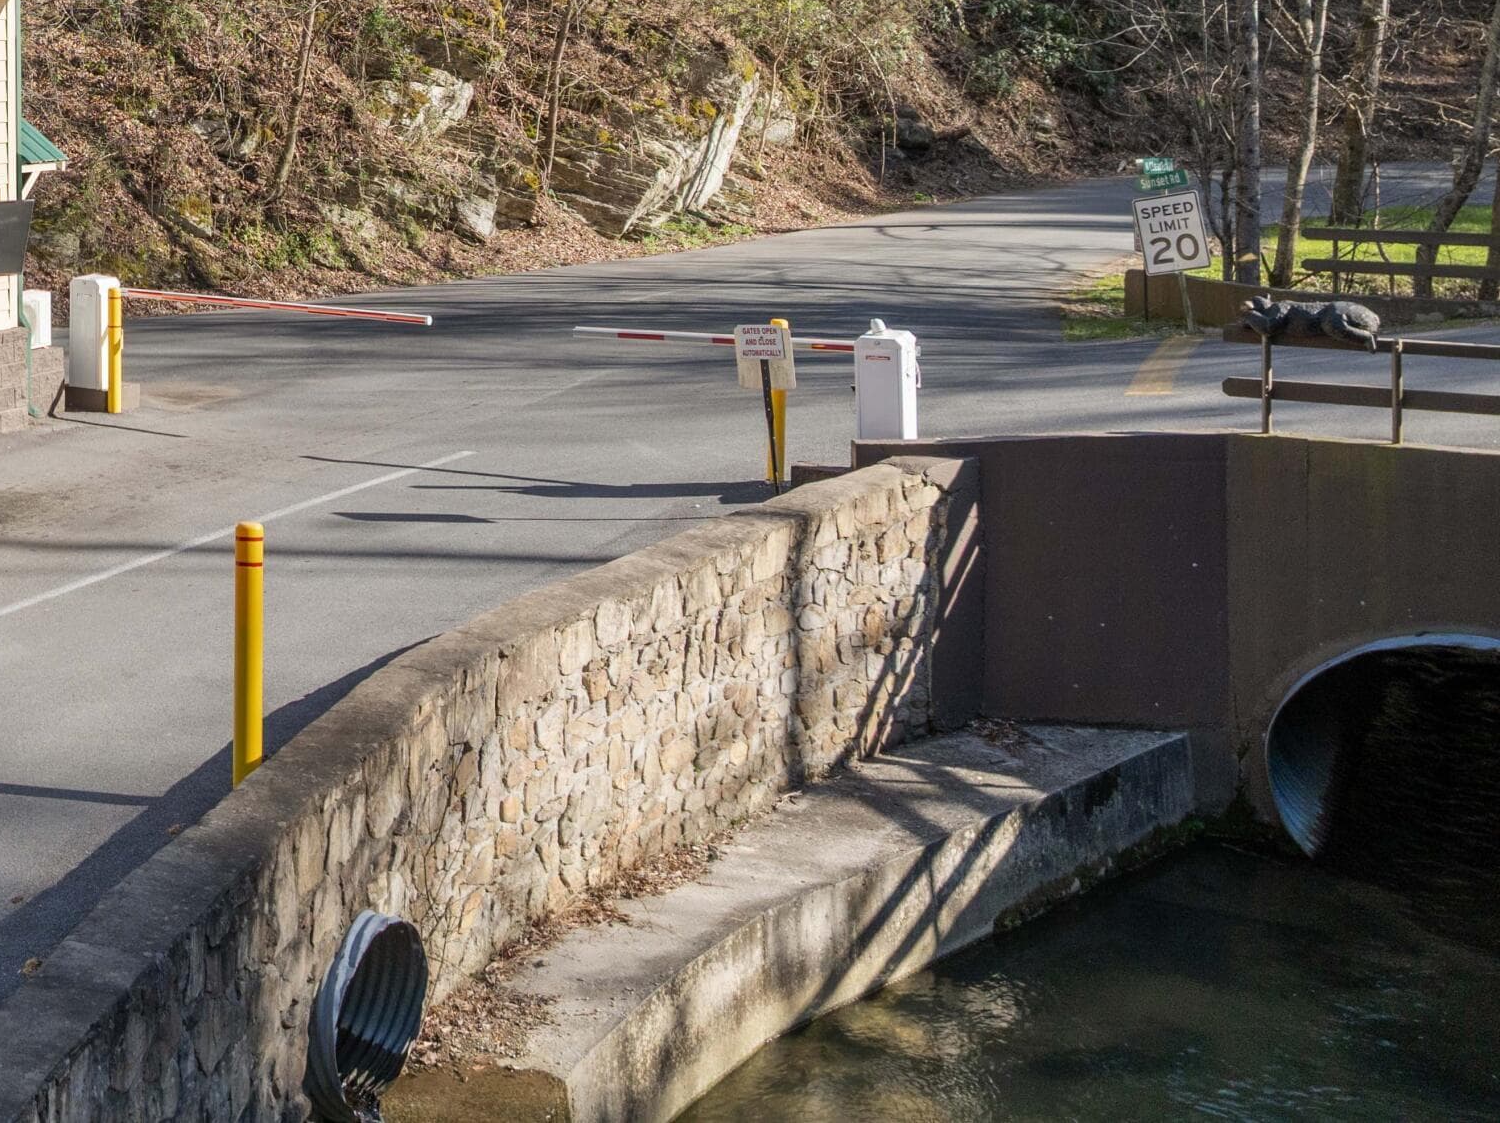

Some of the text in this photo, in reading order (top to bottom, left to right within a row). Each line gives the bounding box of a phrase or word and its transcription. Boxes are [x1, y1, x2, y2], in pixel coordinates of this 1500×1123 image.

[1140, 172, 1180, 189] Sunset Rd
[1141, 201, 1194, 219] SPEED
[1149, 217, 1190, 234] LIMIT
[1149, 233, 1200, 265] 20
[761, 327, 778, 335] OPEN
[742, 349, 781, 357] AUTOMATICALLY
